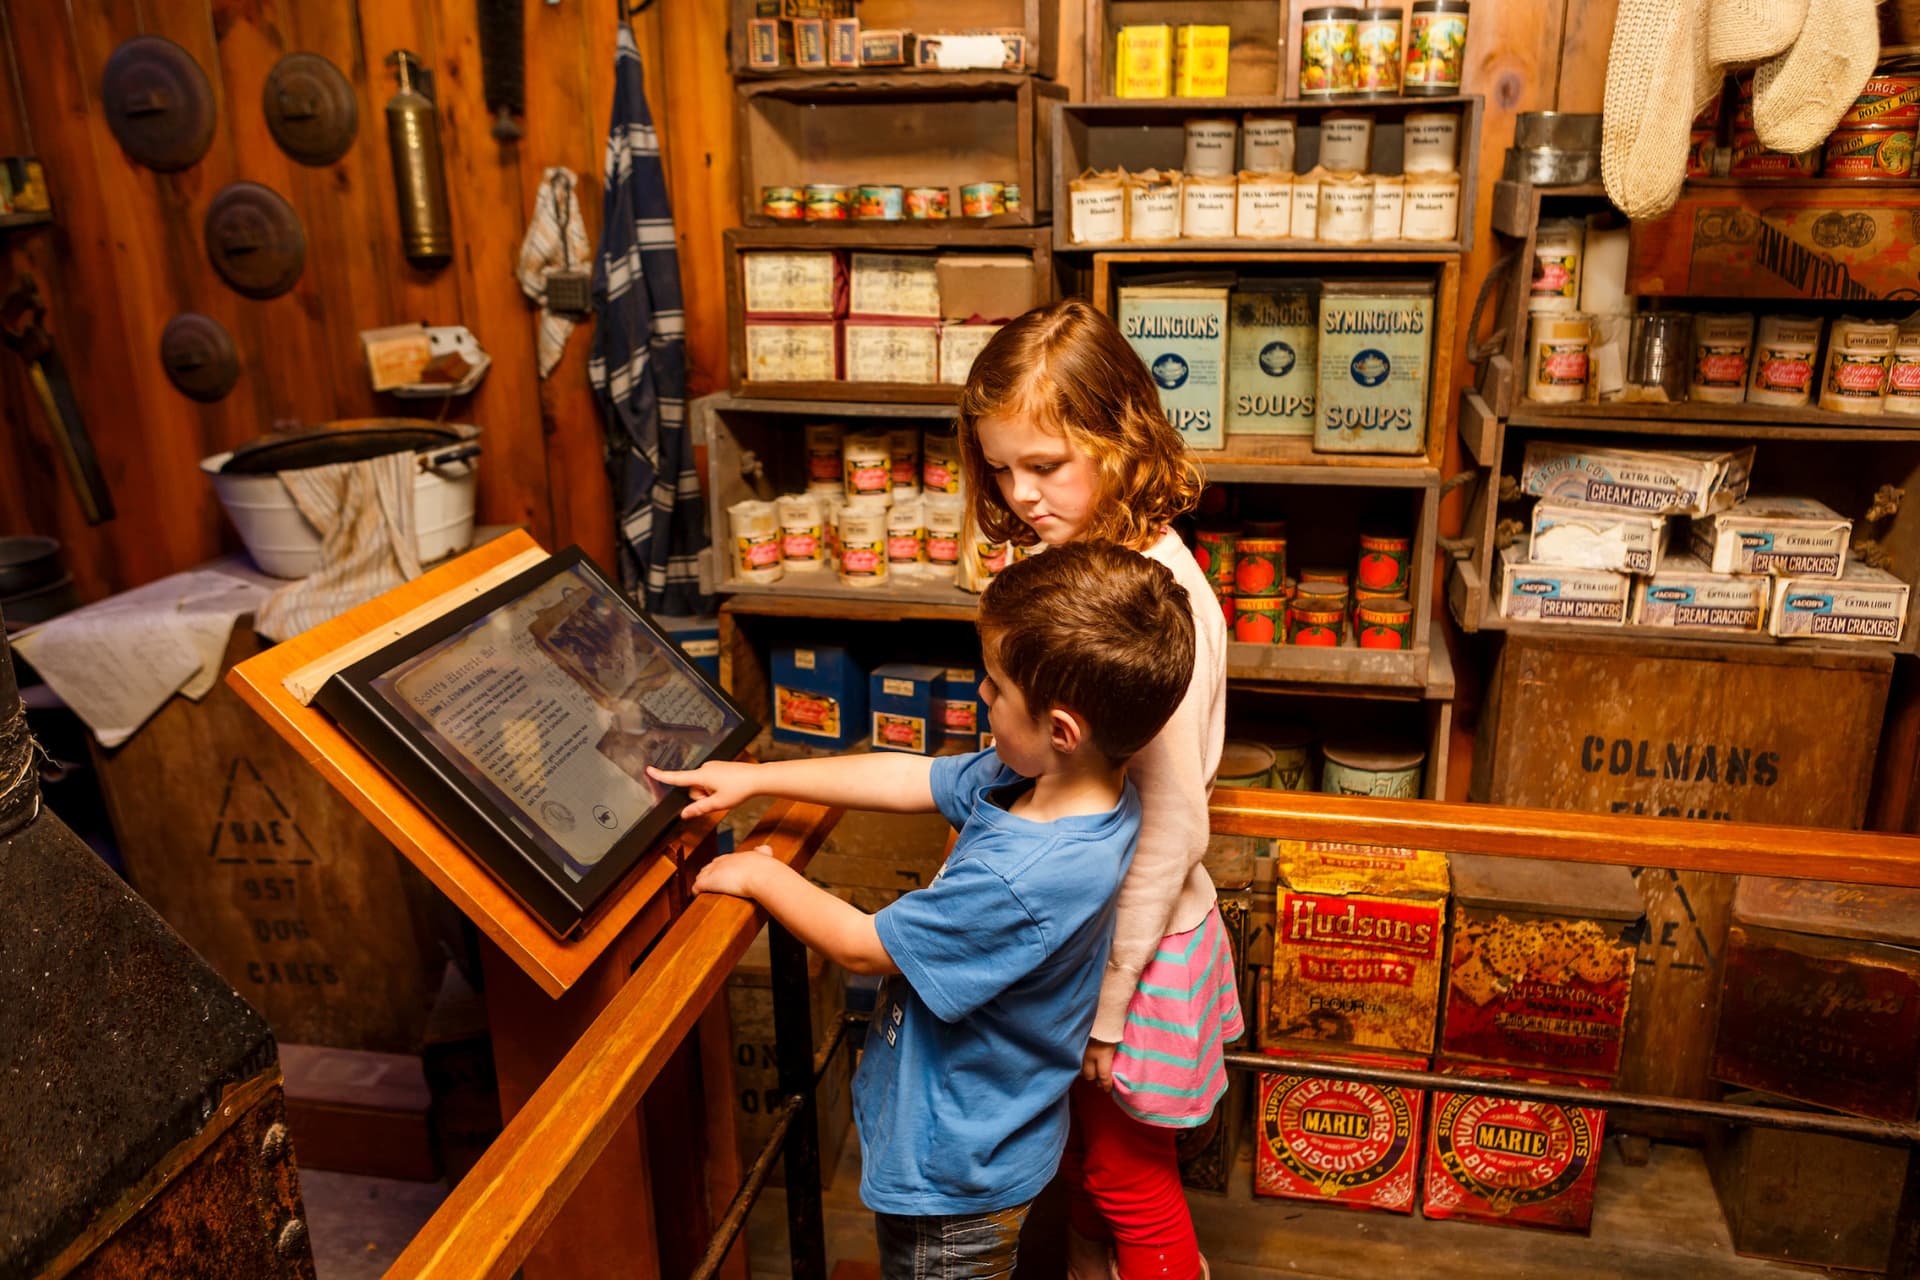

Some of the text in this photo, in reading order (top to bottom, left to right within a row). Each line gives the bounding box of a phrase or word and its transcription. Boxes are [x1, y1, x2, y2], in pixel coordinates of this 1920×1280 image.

[1864, 82, 1897, 95] ORGE
[1858, 101, 1892, 119] ROAST
[1236, 393, 1316, 417] SOUPS
[1162, 407, 1211, 431] UPS
[1325, 404, 1412, 430] SOUPS
[1619, 470, 1650, 482] EXTRA
[1591, 484, 1630, 504] CREAM
[1786, 535, 1834, 547] EXTRA LIGHT
[1625, 551, 1650, 569] KERS
[1755, 554, 1837, 573] CREAM CRACKERS
[1573, 582, 1619, 592] EXTRA LIGHT
[1707, 590, 1753, 600] EXTRA LIGHT
[1543, 600, 1621, 618] CREAM CRACKERS
[1845, 599, 1893, 609] EXTRA LIGHT
[1678, 607, 1757, 625] CREAM CRACKERS
[1814, 618, 1896, 636] CREAM CRACKERS
[1581, 735, 1781, 787] COLMANS
[1290, 899, 1432, 945] Hudsons
[1308, 960, 1408, 981] BISCUITS
[1283, 1079, 1391, 1144] HUNTLEY & PALMERS
[1304, 1111, 1369, 1138] MARIE
[1438, 1094, 1590, 1158] SUPERI SCUITS
[1478, 1126, 1547, 1156] MARIE
[1291, 1138, 1378, 1170] BISCUITS
[1464, 1154, 1554, 1186] BISCUITS
